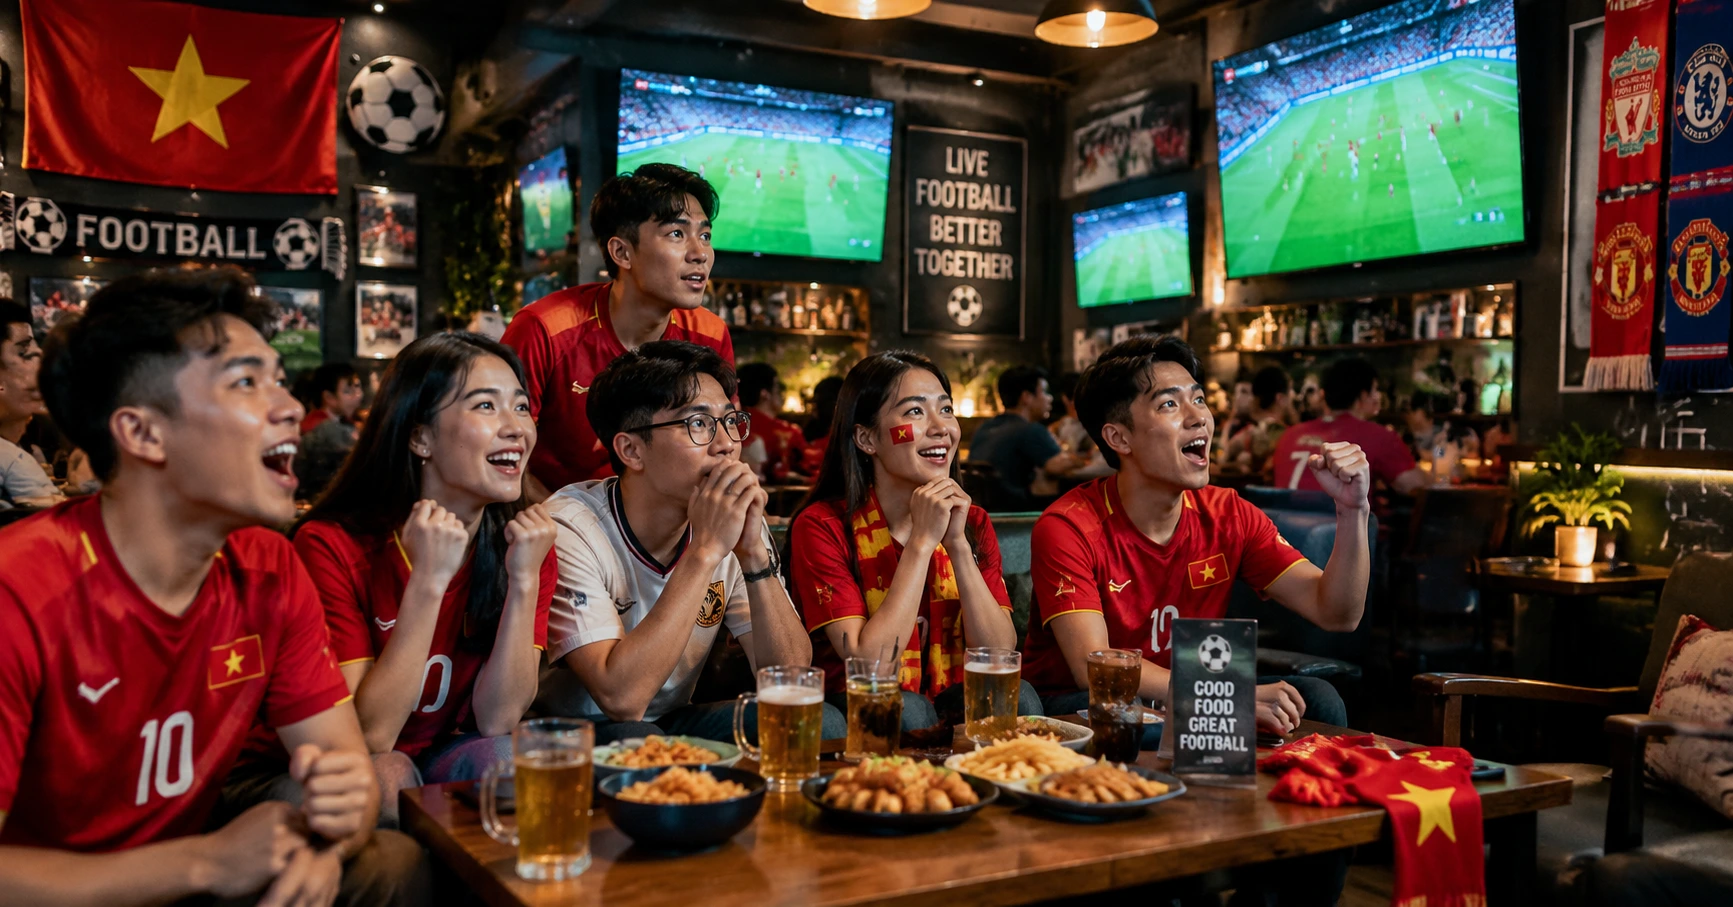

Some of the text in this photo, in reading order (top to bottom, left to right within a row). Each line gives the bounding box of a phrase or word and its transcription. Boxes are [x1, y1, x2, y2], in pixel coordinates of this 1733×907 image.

[945, 146, 989, 177] LIVE
[915, 177, 1017, 214] FOOTBALL
[76, 213, 267, 260] FOOTBALL
[929, 213, 1003, 247] BETTER
[914, 247, 1014, 281] TOGETHER
[1288, 451, 1311, 490] 7
[1194, 698, 1234, 715] FOOD
[1188, 717, 1238, 734] GREAT
[135, 710, 194, 806] 10
[1179, 734, 1249, 752] FOOTBALL
